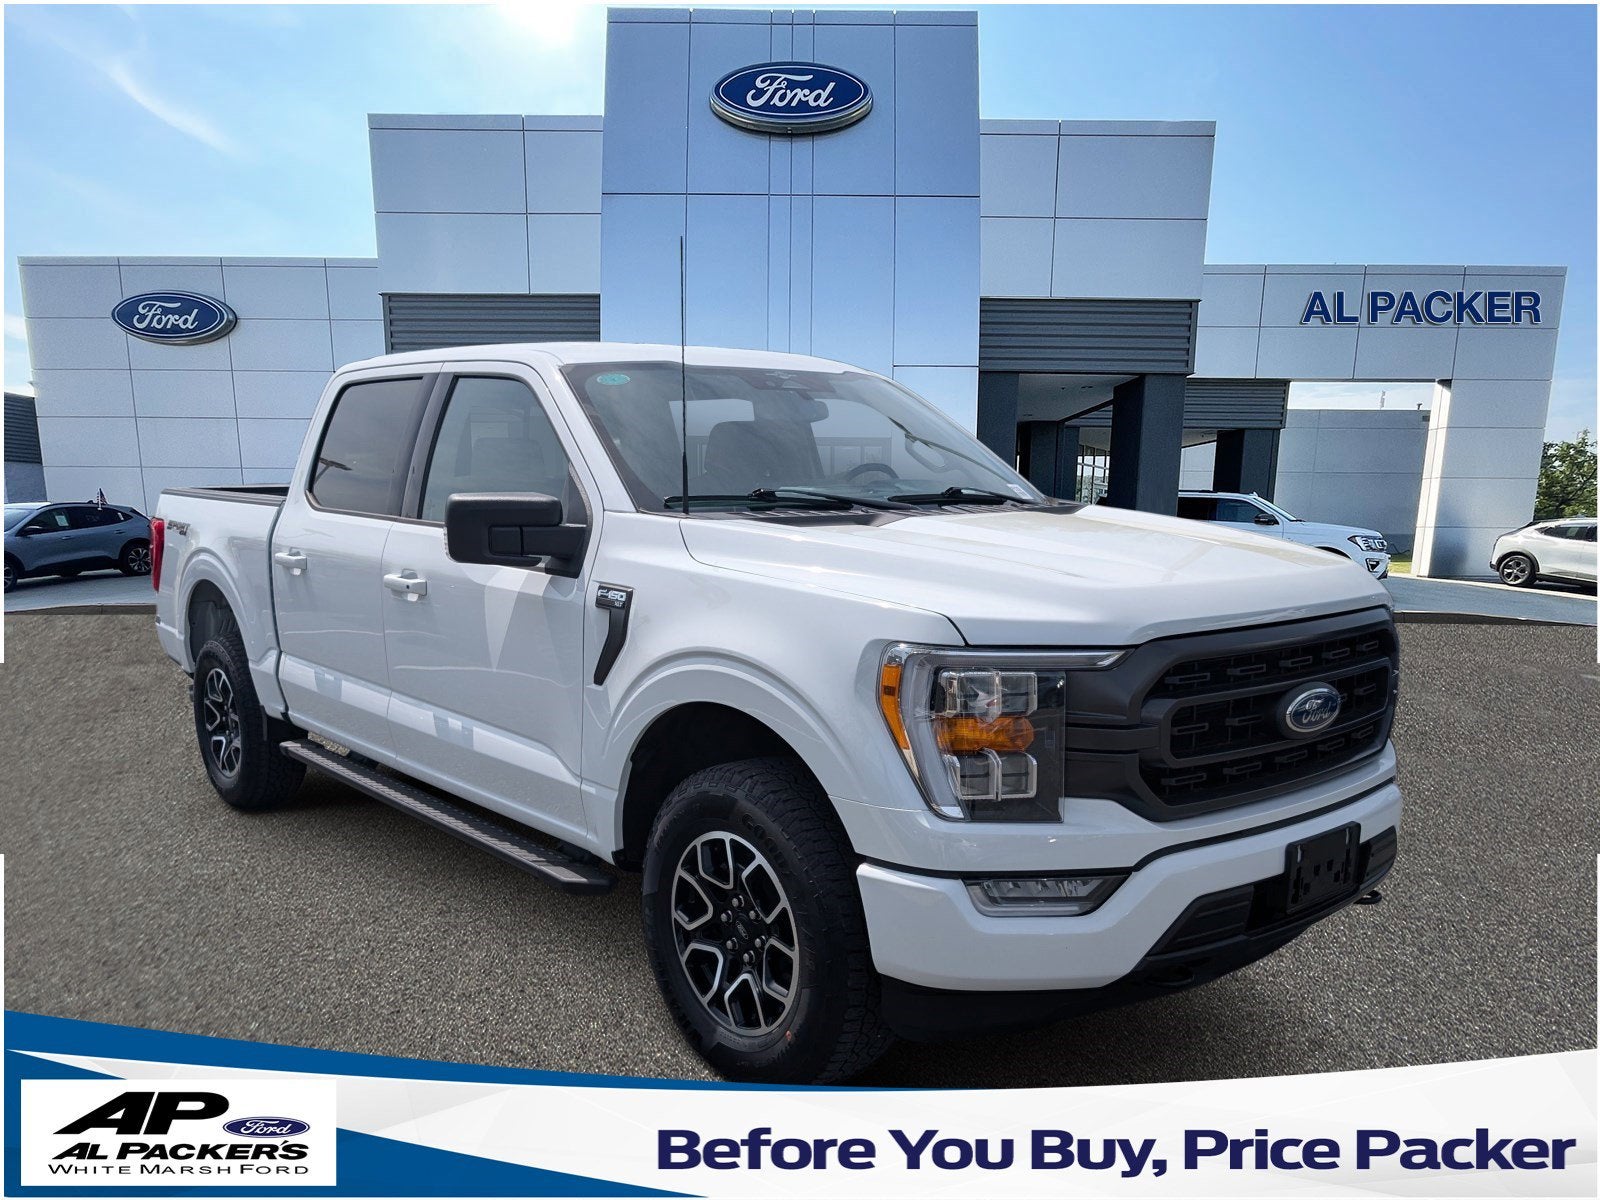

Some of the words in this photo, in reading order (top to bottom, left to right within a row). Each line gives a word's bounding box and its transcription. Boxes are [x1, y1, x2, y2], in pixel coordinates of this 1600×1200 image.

[746, 72, 836, 108] Ford
[133, 301, 199, 329] Ford
[1302, 290, 1359, 324] AL
[1369, 290, 1542, 325] PACKER
[1302, 698, 1332, 723] Ford
